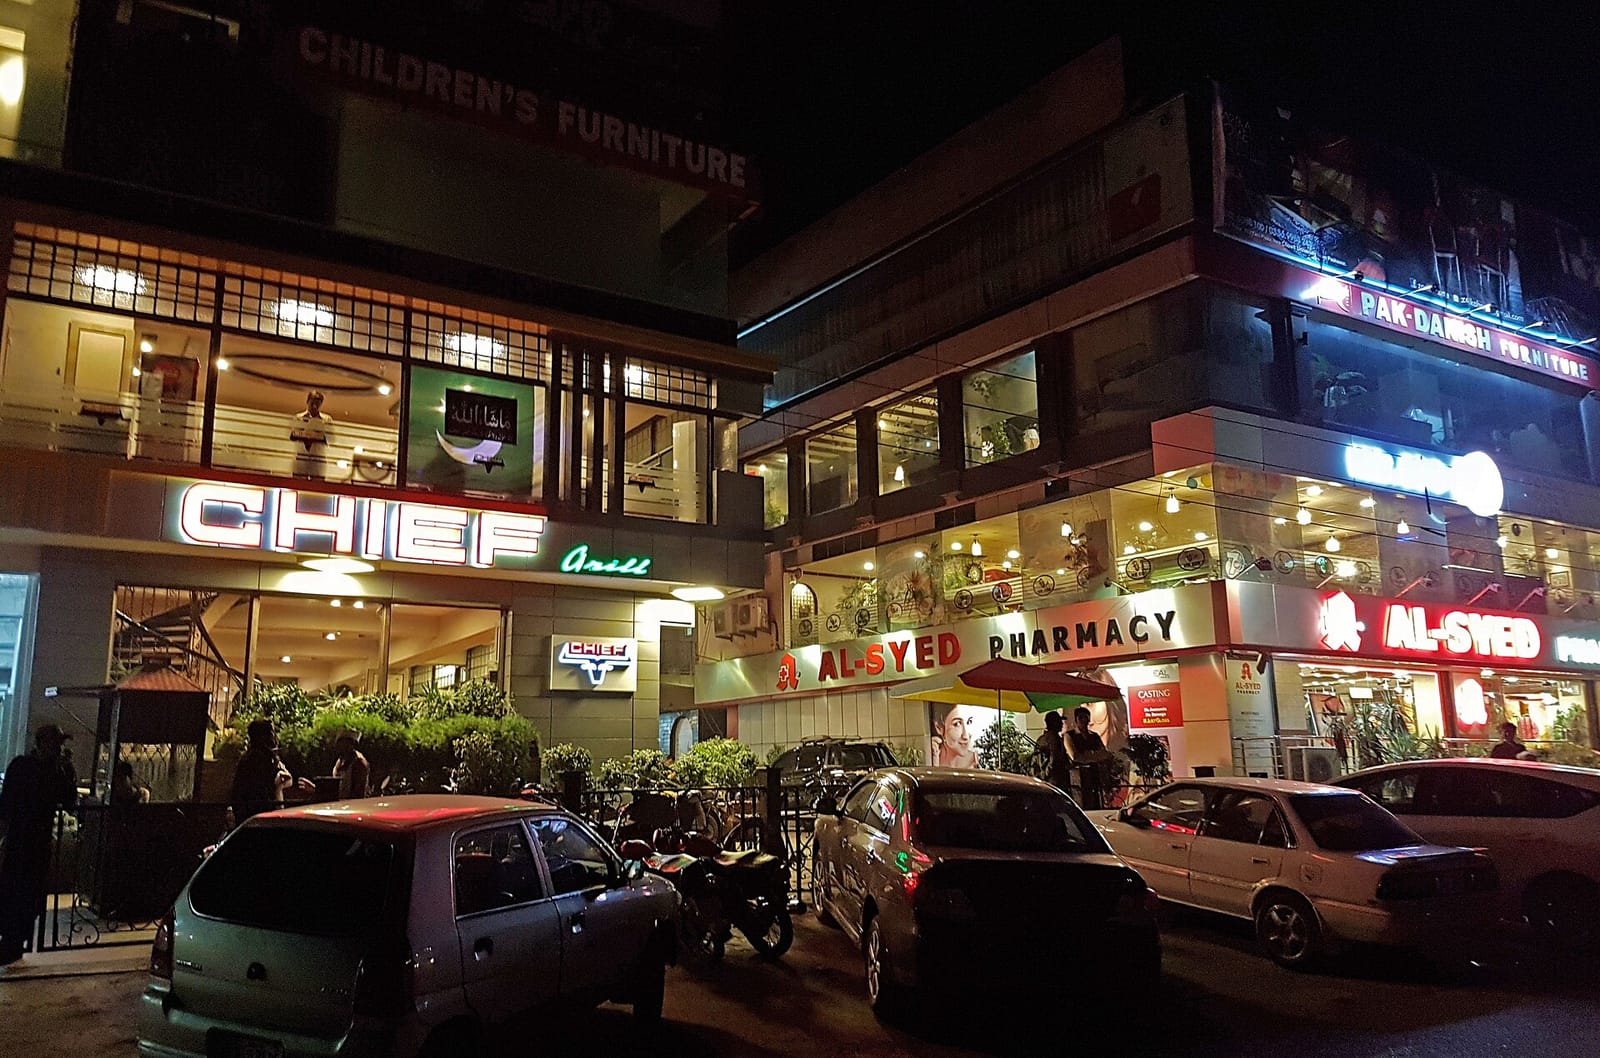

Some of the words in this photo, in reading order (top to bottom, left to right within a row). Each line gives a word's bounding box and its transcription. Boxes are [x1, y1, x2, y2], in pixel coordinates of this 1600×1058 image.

[300, 27, 539, 122] CHILDREN'S
[558, 99, 746, 188] FURNITURE
[1500, 338, 1589, 381] FURNITURE
[180, 480, 547, 567] CHIEF
[561, 544, 652, 576] Grill
[568, 641, 627, 657] CHIEF
[818, 631, 961, 682] AL-SYED
[989, 610, 1176, 659] PHARMACY
[1385, 603, 1541, 658] AL-SYED
[1137, 688, 1170, 699] CASTING
[1234, 682, 1262, 691] AL-SYED
